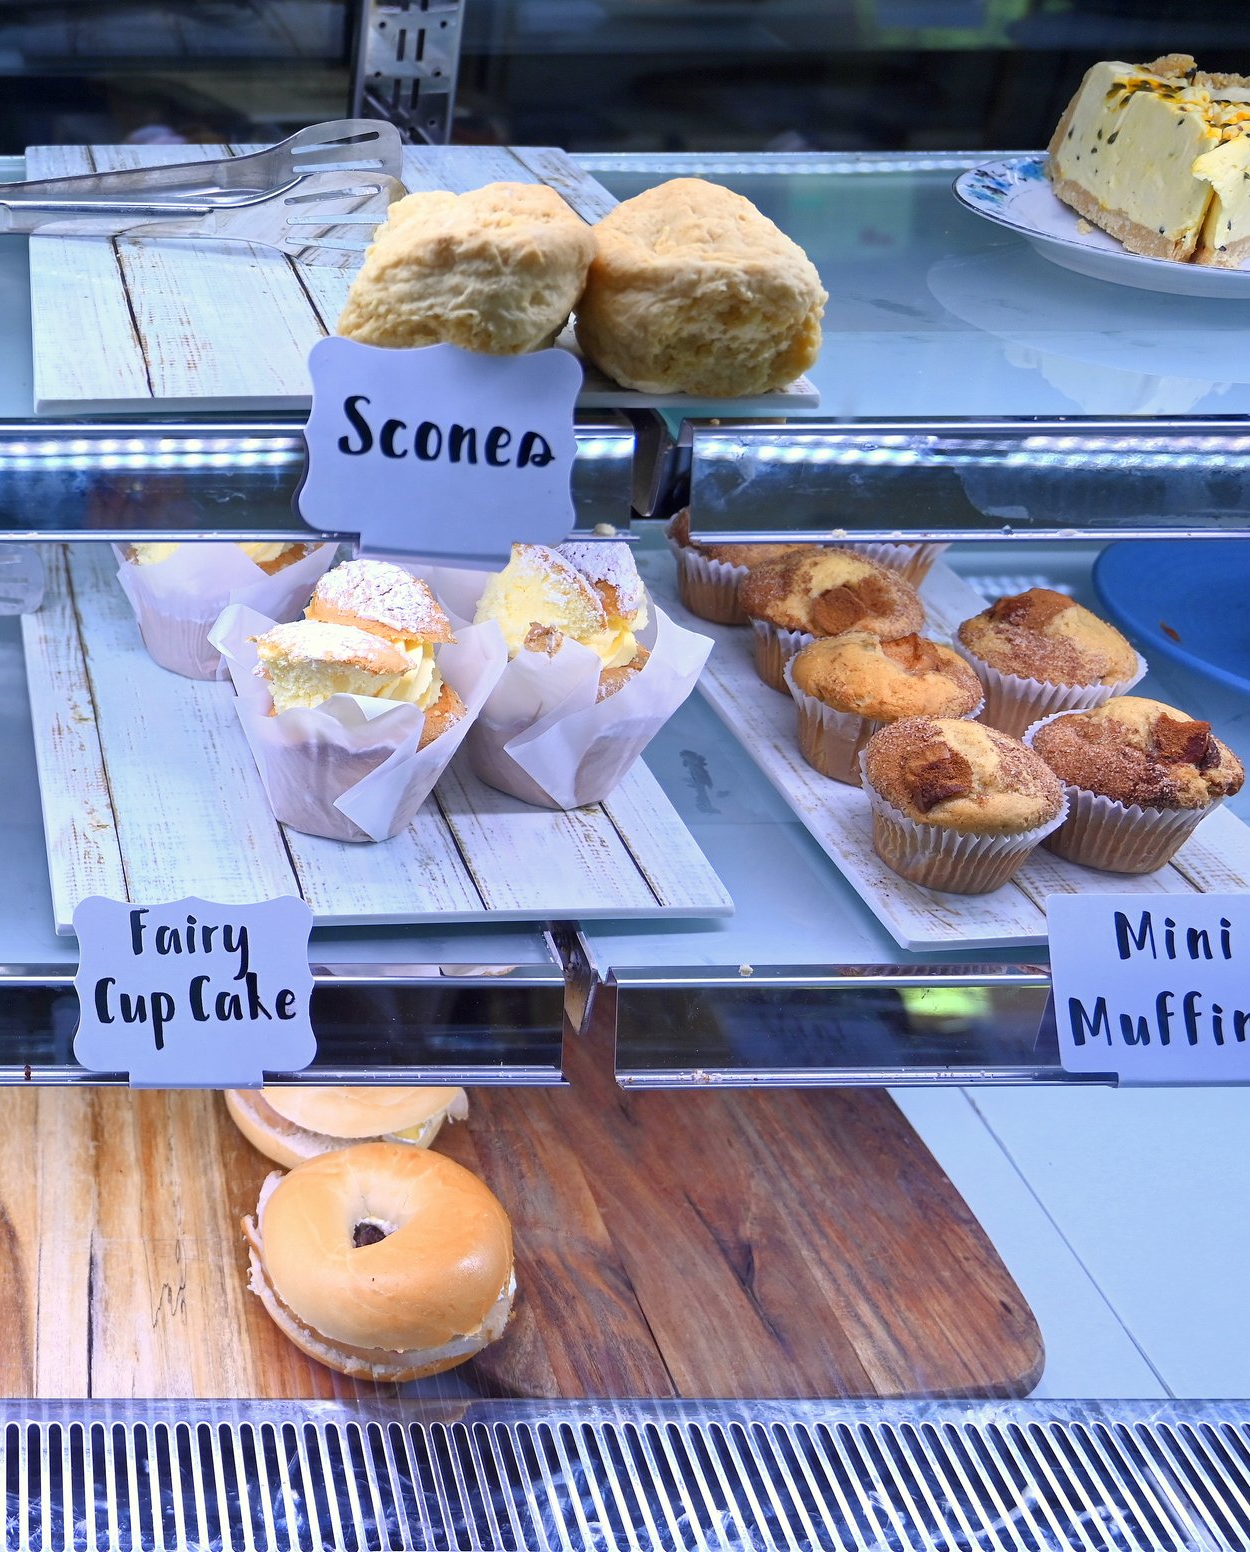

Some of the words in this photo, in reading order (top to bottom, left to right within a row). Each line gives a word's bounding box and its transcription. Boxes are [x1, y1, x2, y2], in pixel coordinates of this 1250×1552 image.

[337, 395, 556, 469] Scones
[129, 907, 250, 981] Fairy
[1113, 910, 1232, 960] Mini
[94, 977, 176, 1051] Cup
[188, 971, 297, 1022] Cake
